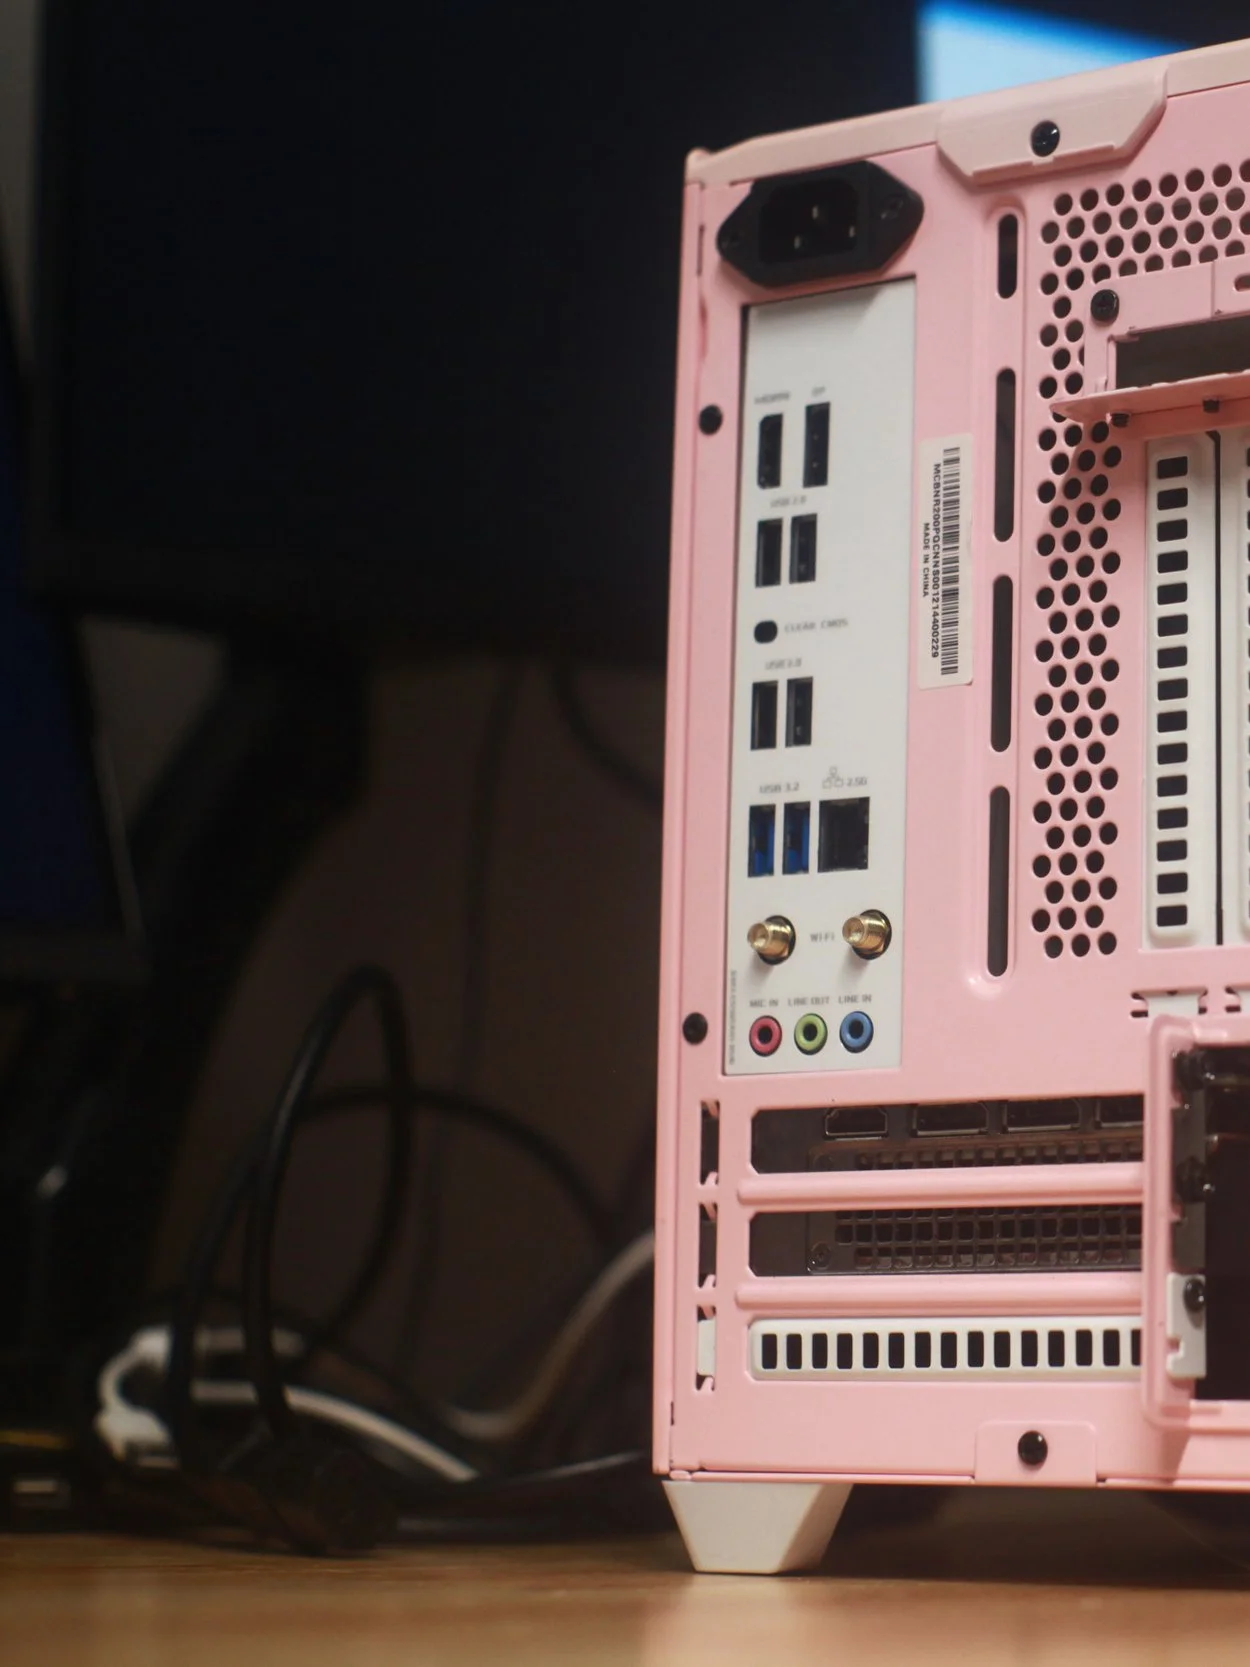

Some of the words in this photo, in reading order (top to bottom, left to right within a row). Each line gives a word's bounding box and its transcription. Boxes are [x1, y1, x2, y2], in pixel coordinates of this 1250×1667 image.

[922, 554, 930, 564] IN
[759, 784, 781, 794] USB
[749, 999, 766, 1008] MIC
[769, 998, 779, 1007] IN
[788, 996, 807, 1007] LINE
[810, 995, 830, 1005] OUT
[838, 995, 859, 1004] LINE
[862, 994, 872, 1003] IN
